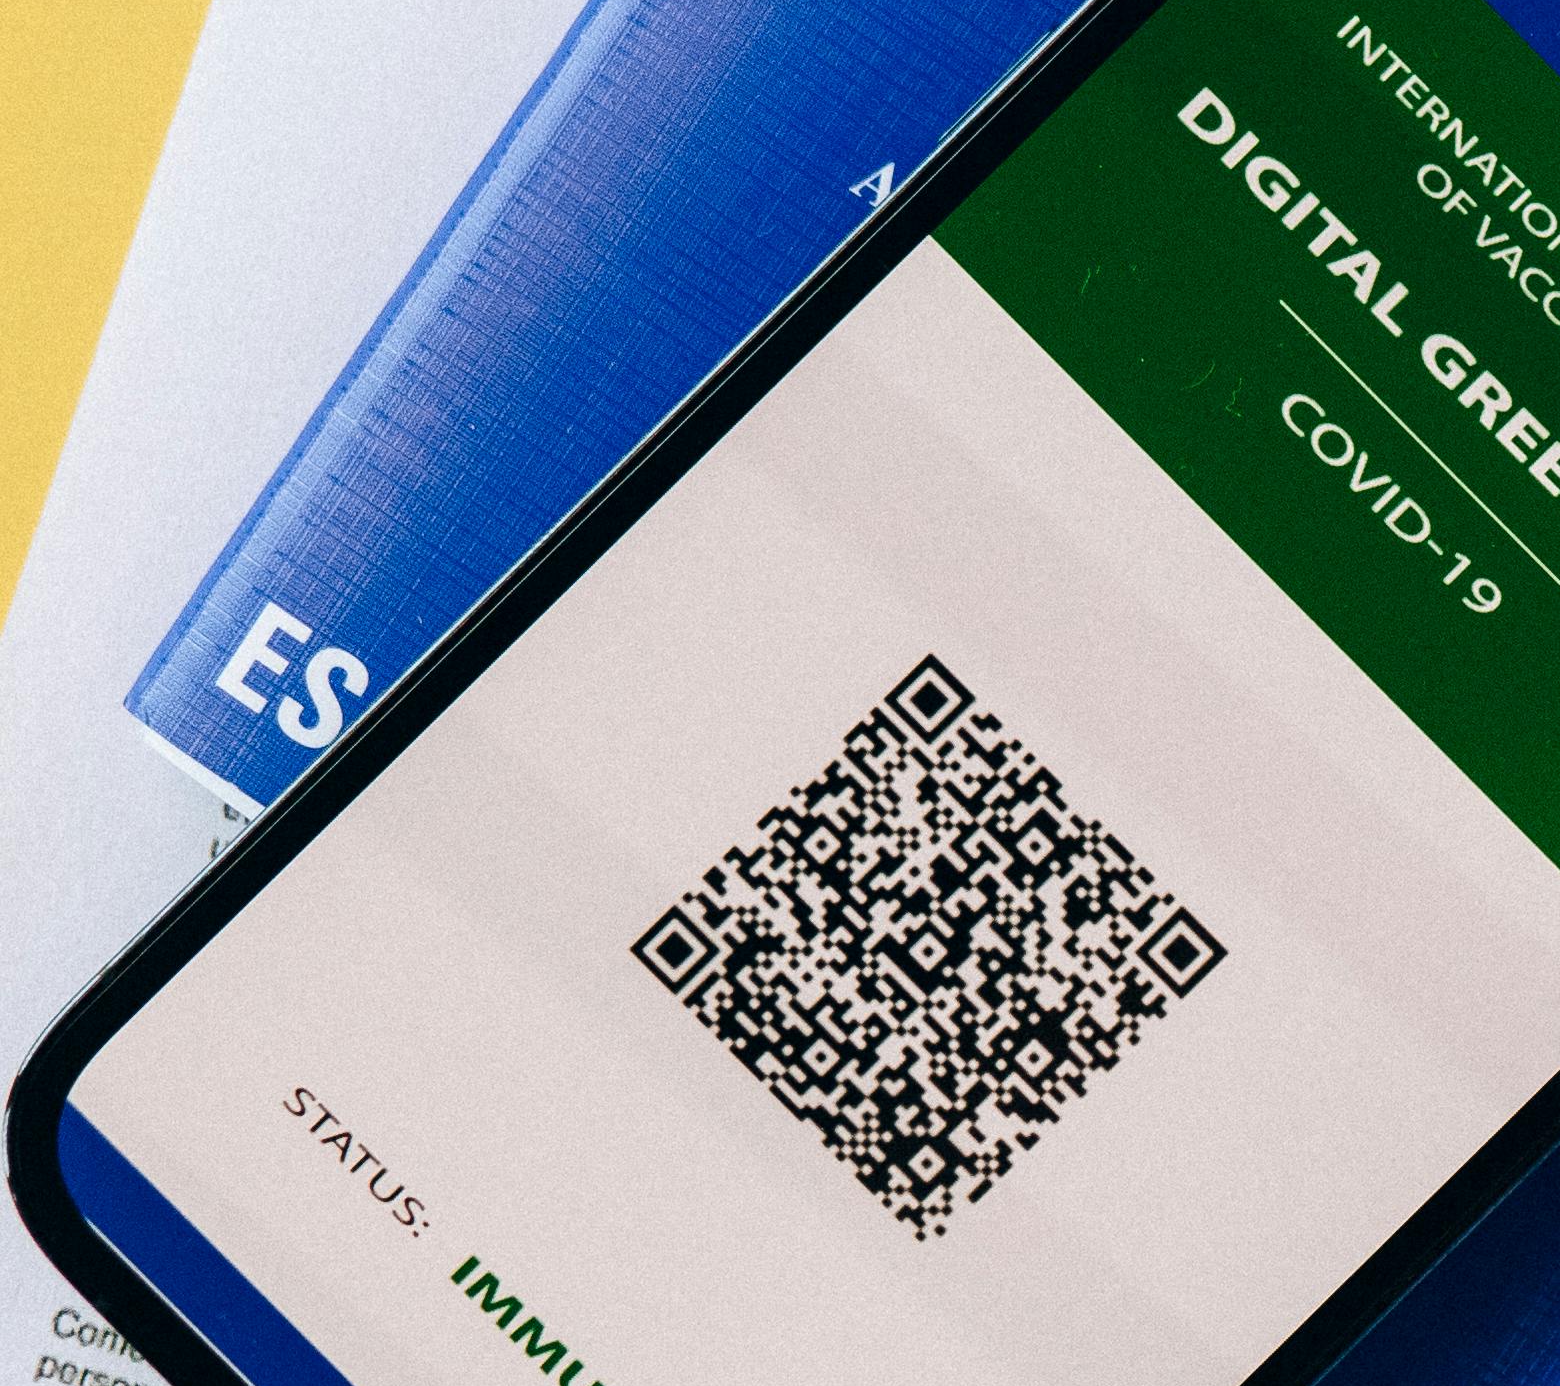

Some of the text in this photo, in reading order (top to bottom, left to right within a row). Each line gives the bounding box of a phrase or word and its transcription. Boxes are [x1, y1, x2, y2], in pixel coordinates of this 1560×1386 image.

[1176, 86, 1409, 337] DIGITAL
[1416, 163, 1477, 215] OF
[1281, 393, 1502, 613] COVID-19
[282, 1087, 429, 1237] STATUS:
